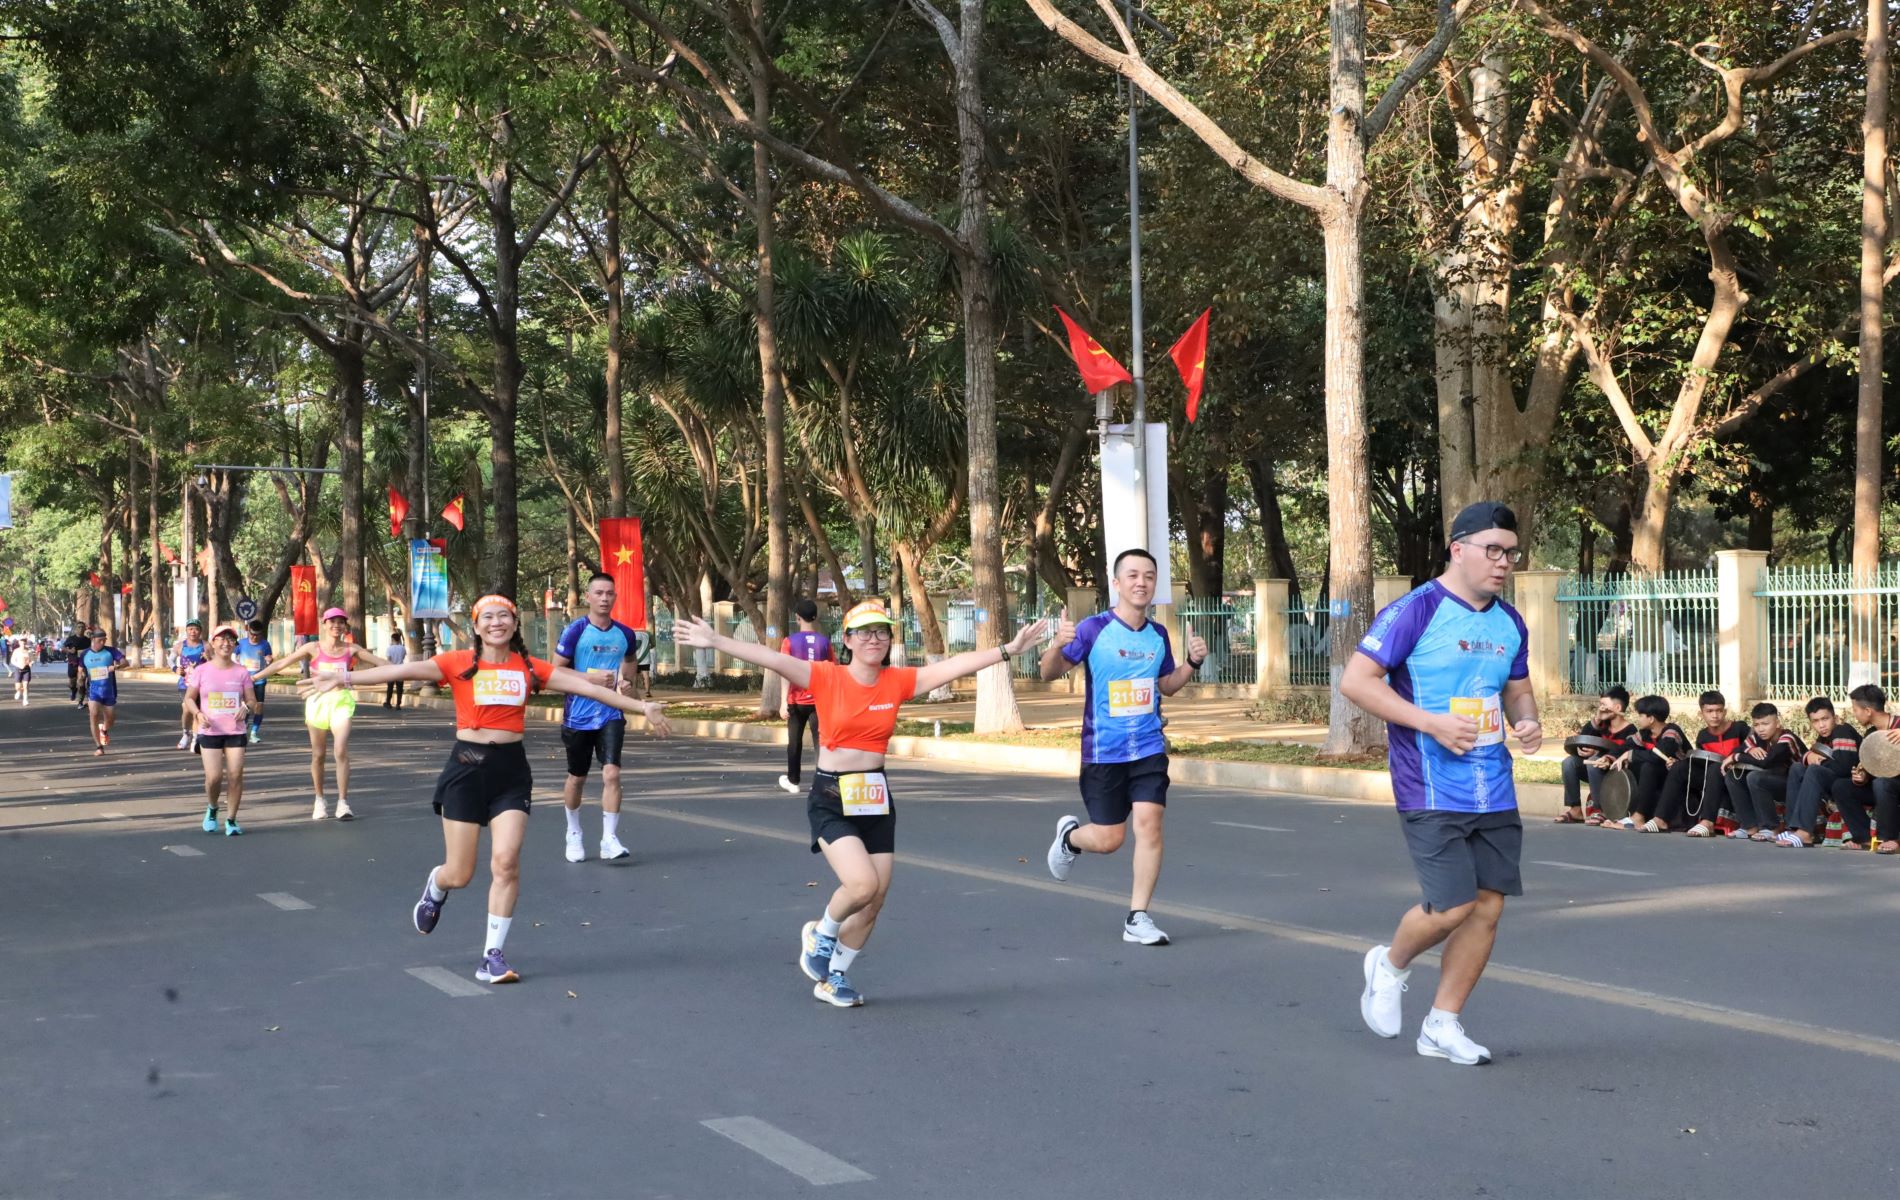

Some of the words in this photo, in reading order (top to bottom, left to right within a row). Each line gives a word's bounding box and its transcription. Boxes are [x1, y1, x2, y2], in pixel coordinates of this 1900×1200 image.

[477, 680, 520, 692] 21249
[1112, 690, 1150, 704] 21187
[846, 785, 883, 801] 21107
